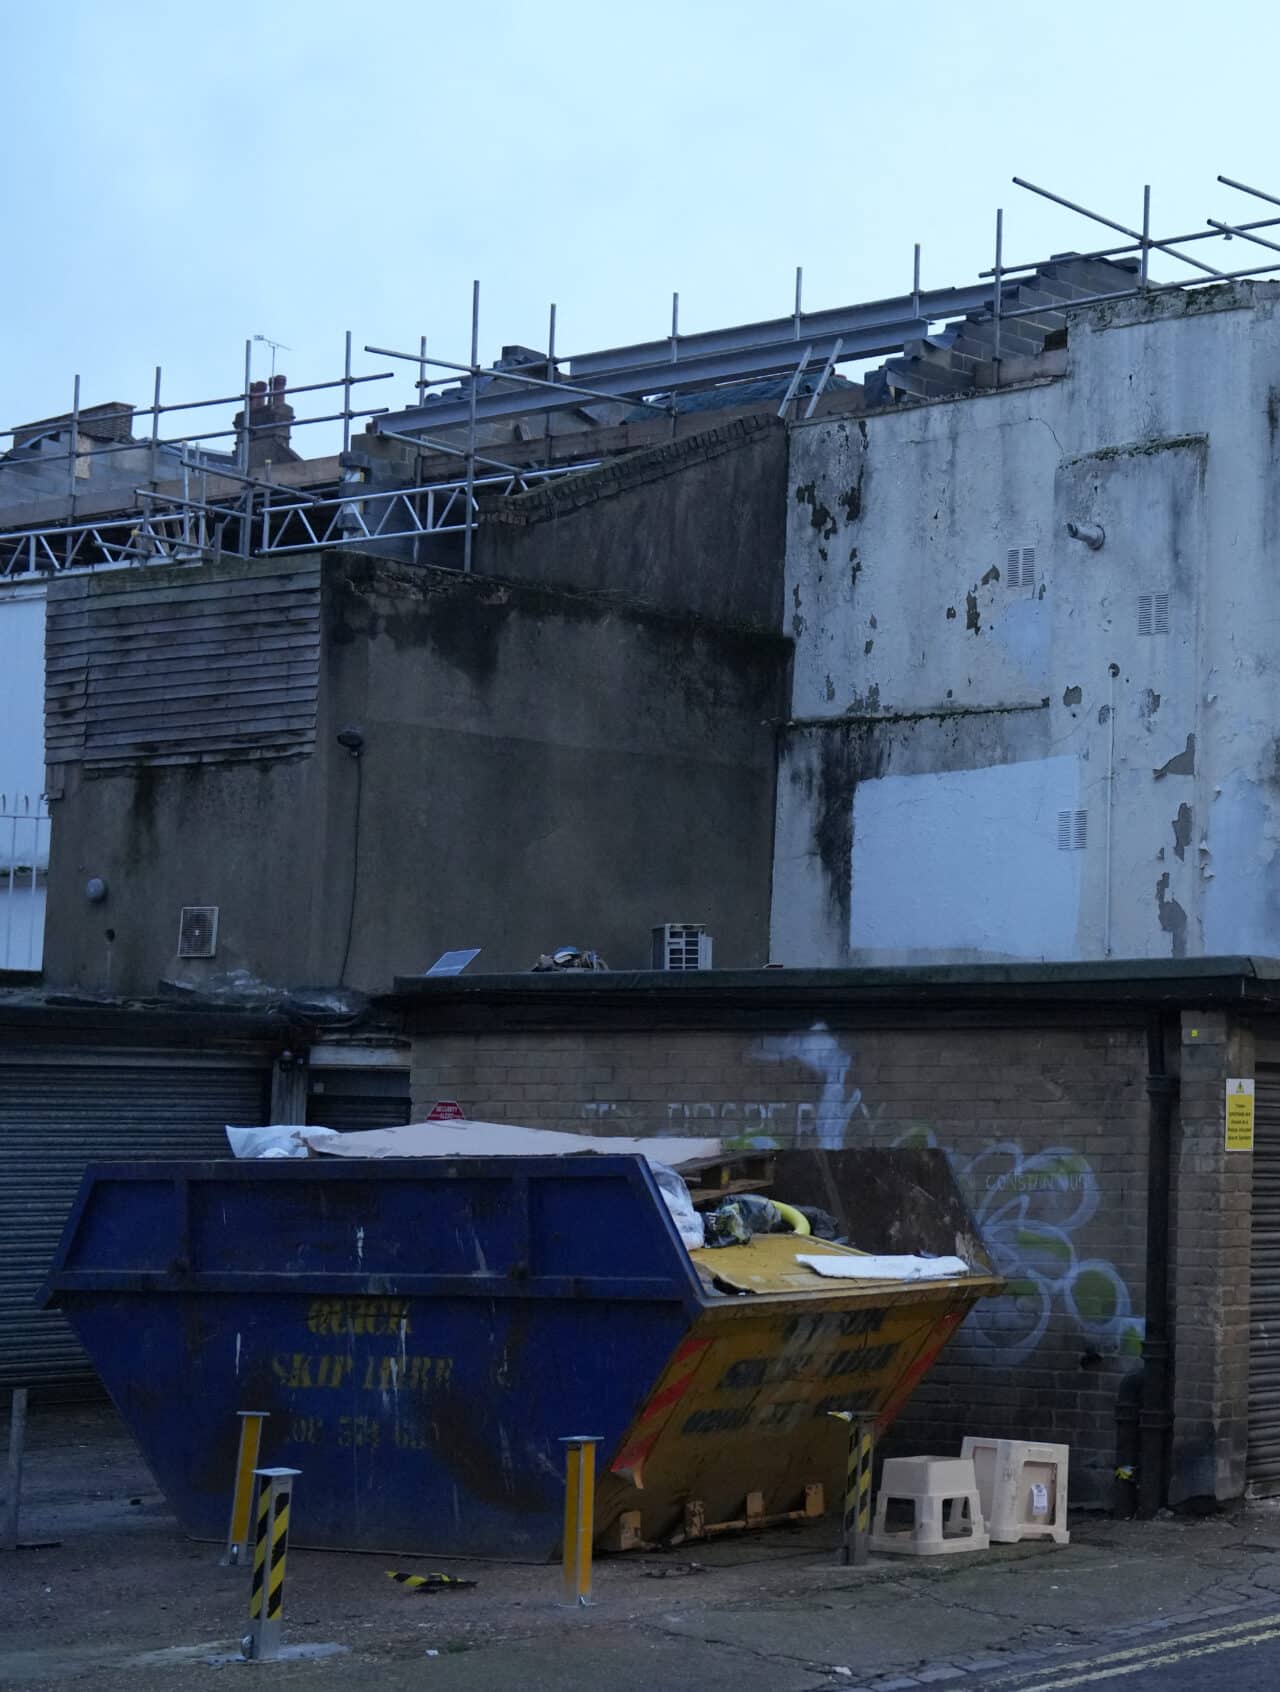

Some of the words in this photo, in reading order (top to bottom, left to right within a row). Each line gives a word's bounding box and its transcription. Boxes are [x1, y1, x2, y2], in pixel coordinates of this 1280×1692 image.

[985, 1174, 1066, 1191] CONSTAN
[307, 1298, 415, 1335] QUICK
[271, 1352, 353, 1388] SKIP
